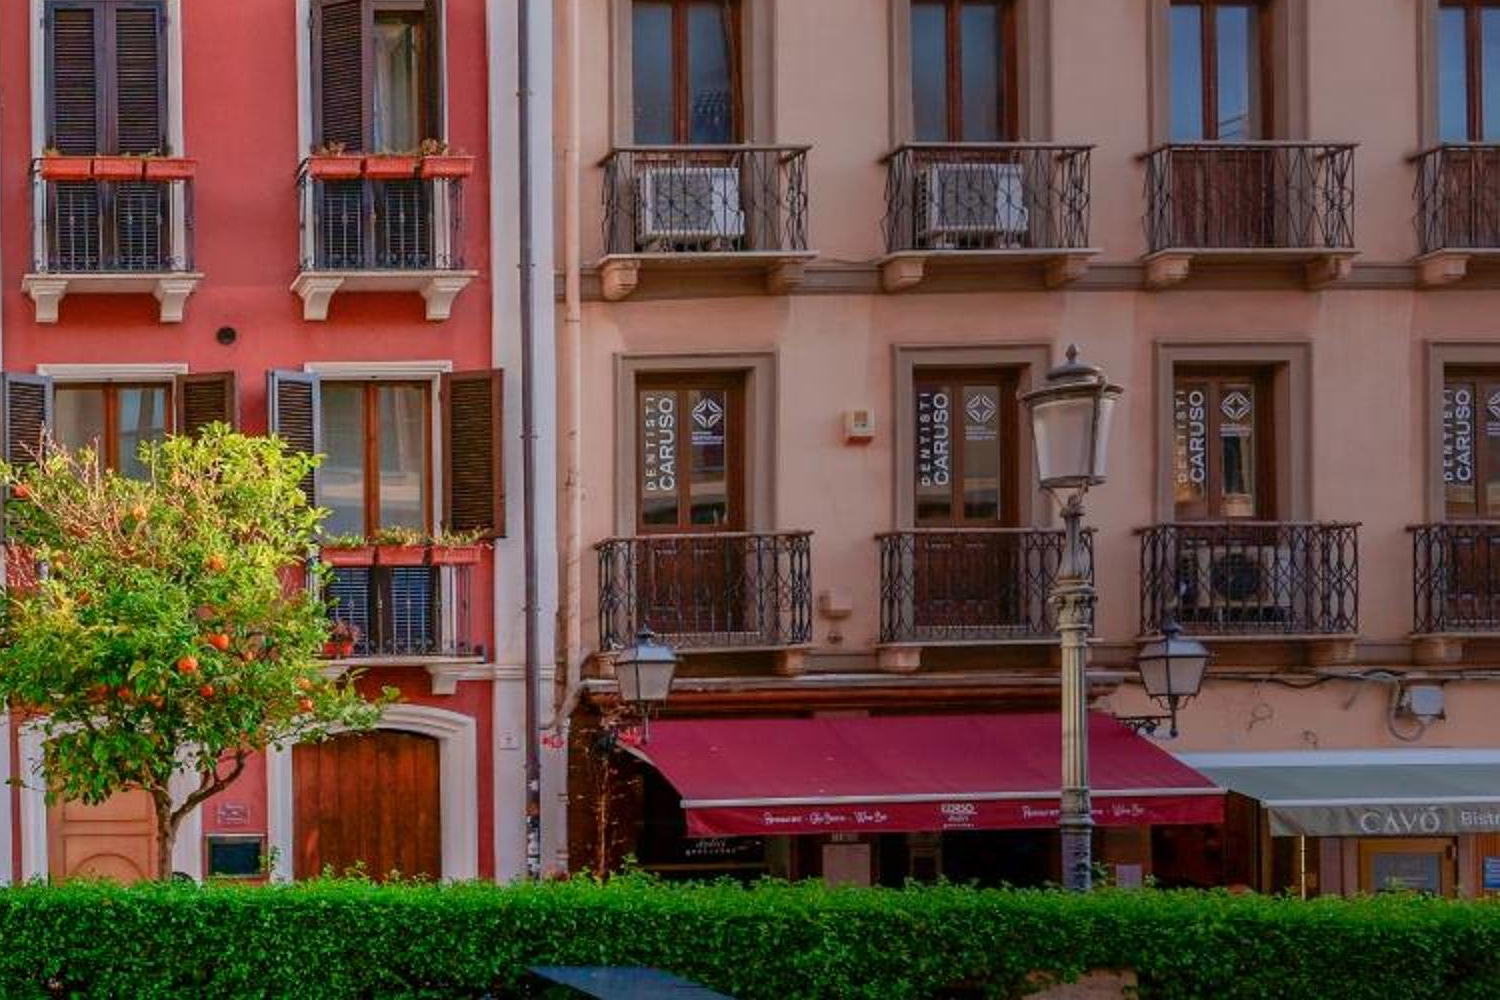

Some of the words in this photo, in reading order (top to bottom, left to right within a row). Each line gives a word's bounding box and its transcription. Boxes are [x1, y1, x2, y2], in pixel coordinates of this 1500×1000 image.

[645, 397, 656, 491] DENTISTI
[659, 398, 675, 491] CARUSO
[920, 393, 931, 487] DENTISTI
[933, 393, 949, 486] CARUSO
[1189, 391, 1205, 483] CARUSO
[1455, 389, 1471, 481] CARUSO
